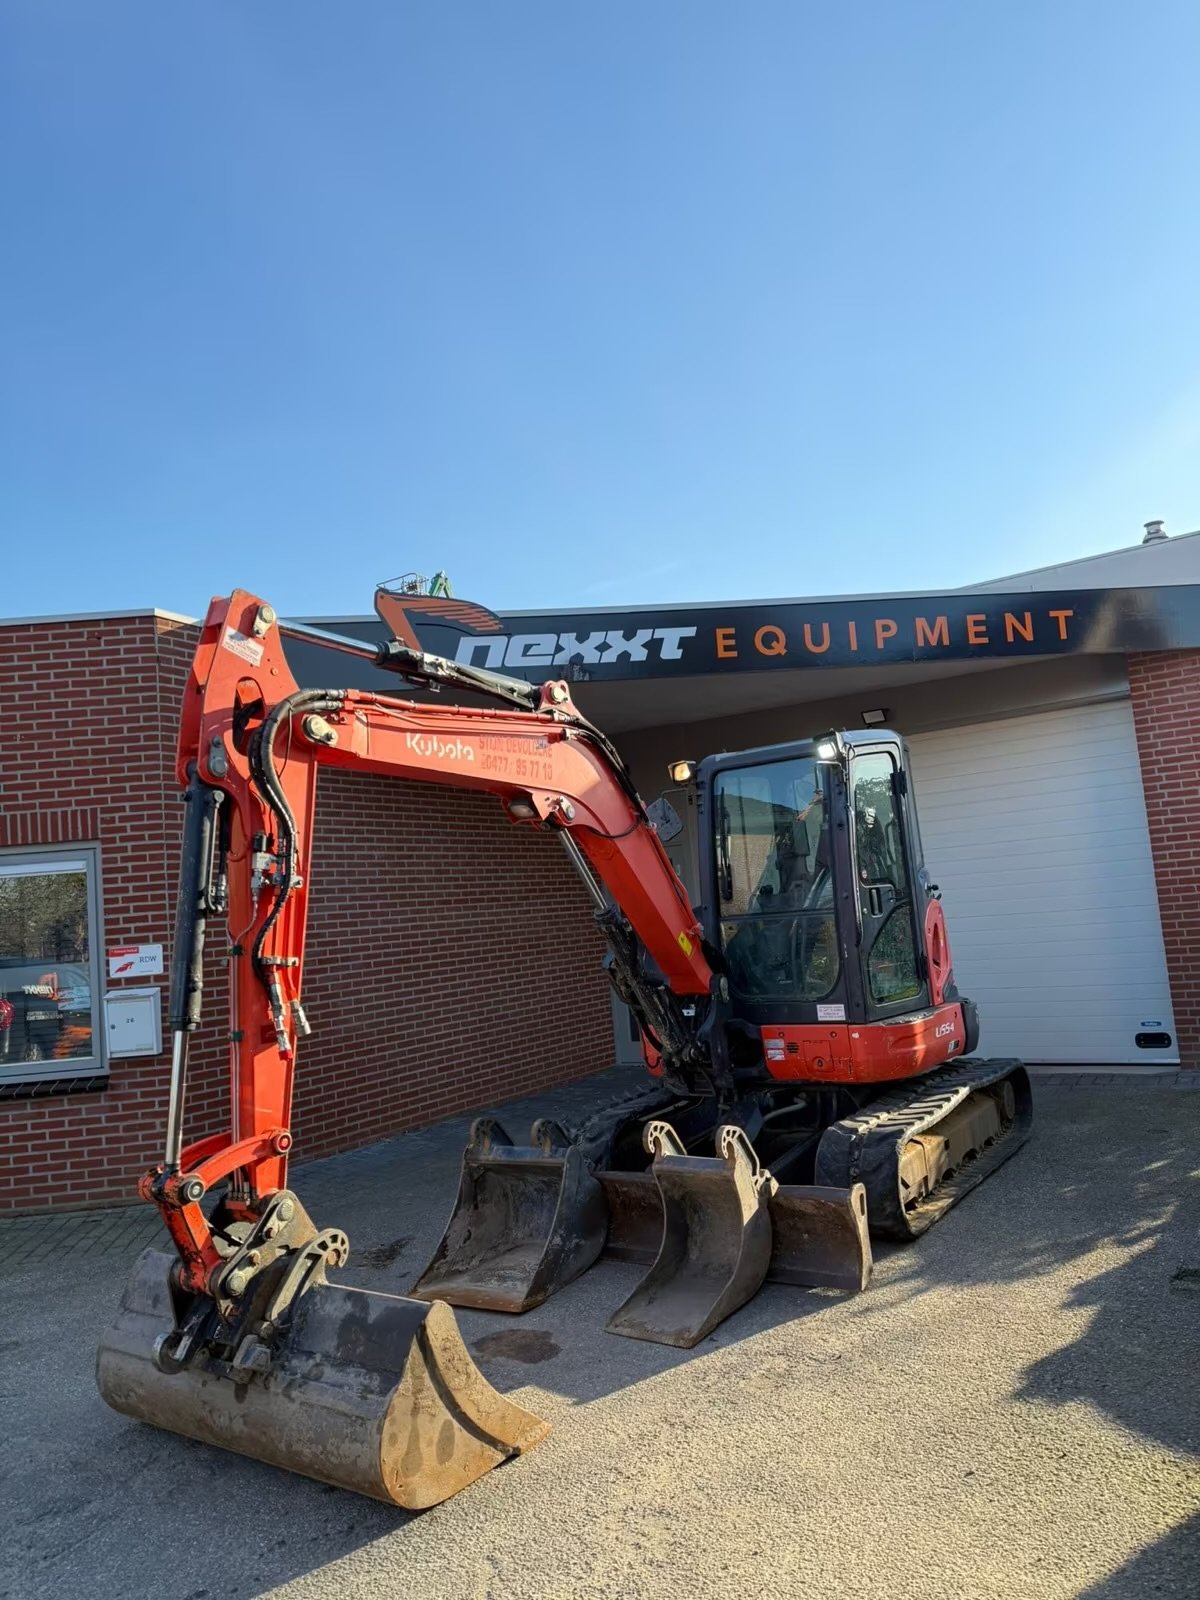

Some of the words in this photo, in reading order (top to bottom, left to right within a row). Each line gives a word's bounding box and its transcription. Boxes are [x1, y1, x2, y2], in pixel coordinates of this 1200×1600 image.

[715, 609, 1074, 658] EQUIPMENT
[405, 732, 475, 760] Kubota
[529, 760, 540, 778] 77
[139, 955, 157, 963] RDW
